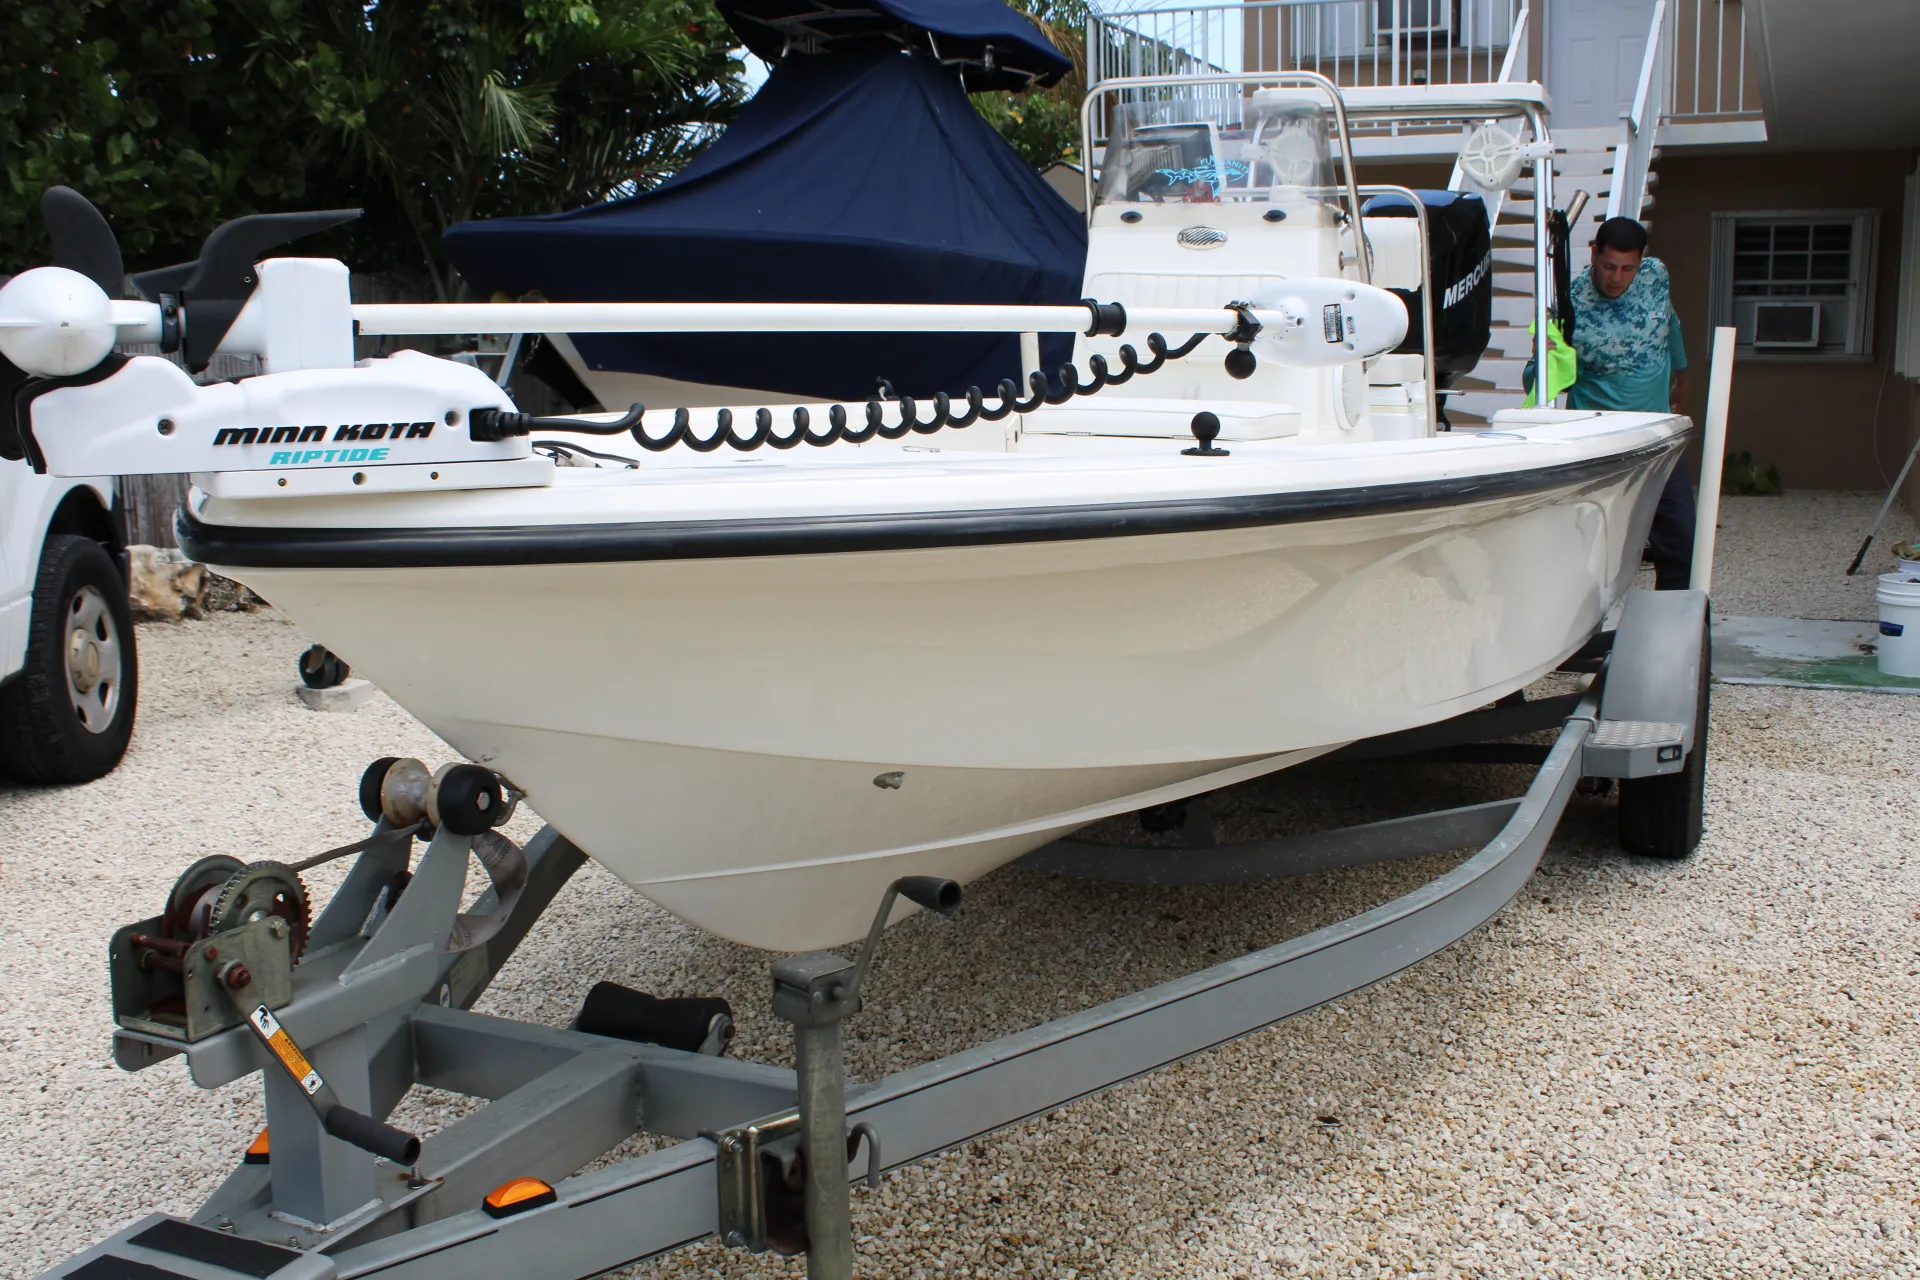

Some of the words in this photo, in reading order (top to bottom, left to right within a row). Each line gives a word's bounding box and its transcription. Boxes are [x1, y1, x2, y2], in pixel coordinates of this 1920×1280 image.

[213, 425, 328, 446] MINN
[332, 421, 436, 442] KOTA
[269, 447, 391, 465] RIPTIDE
